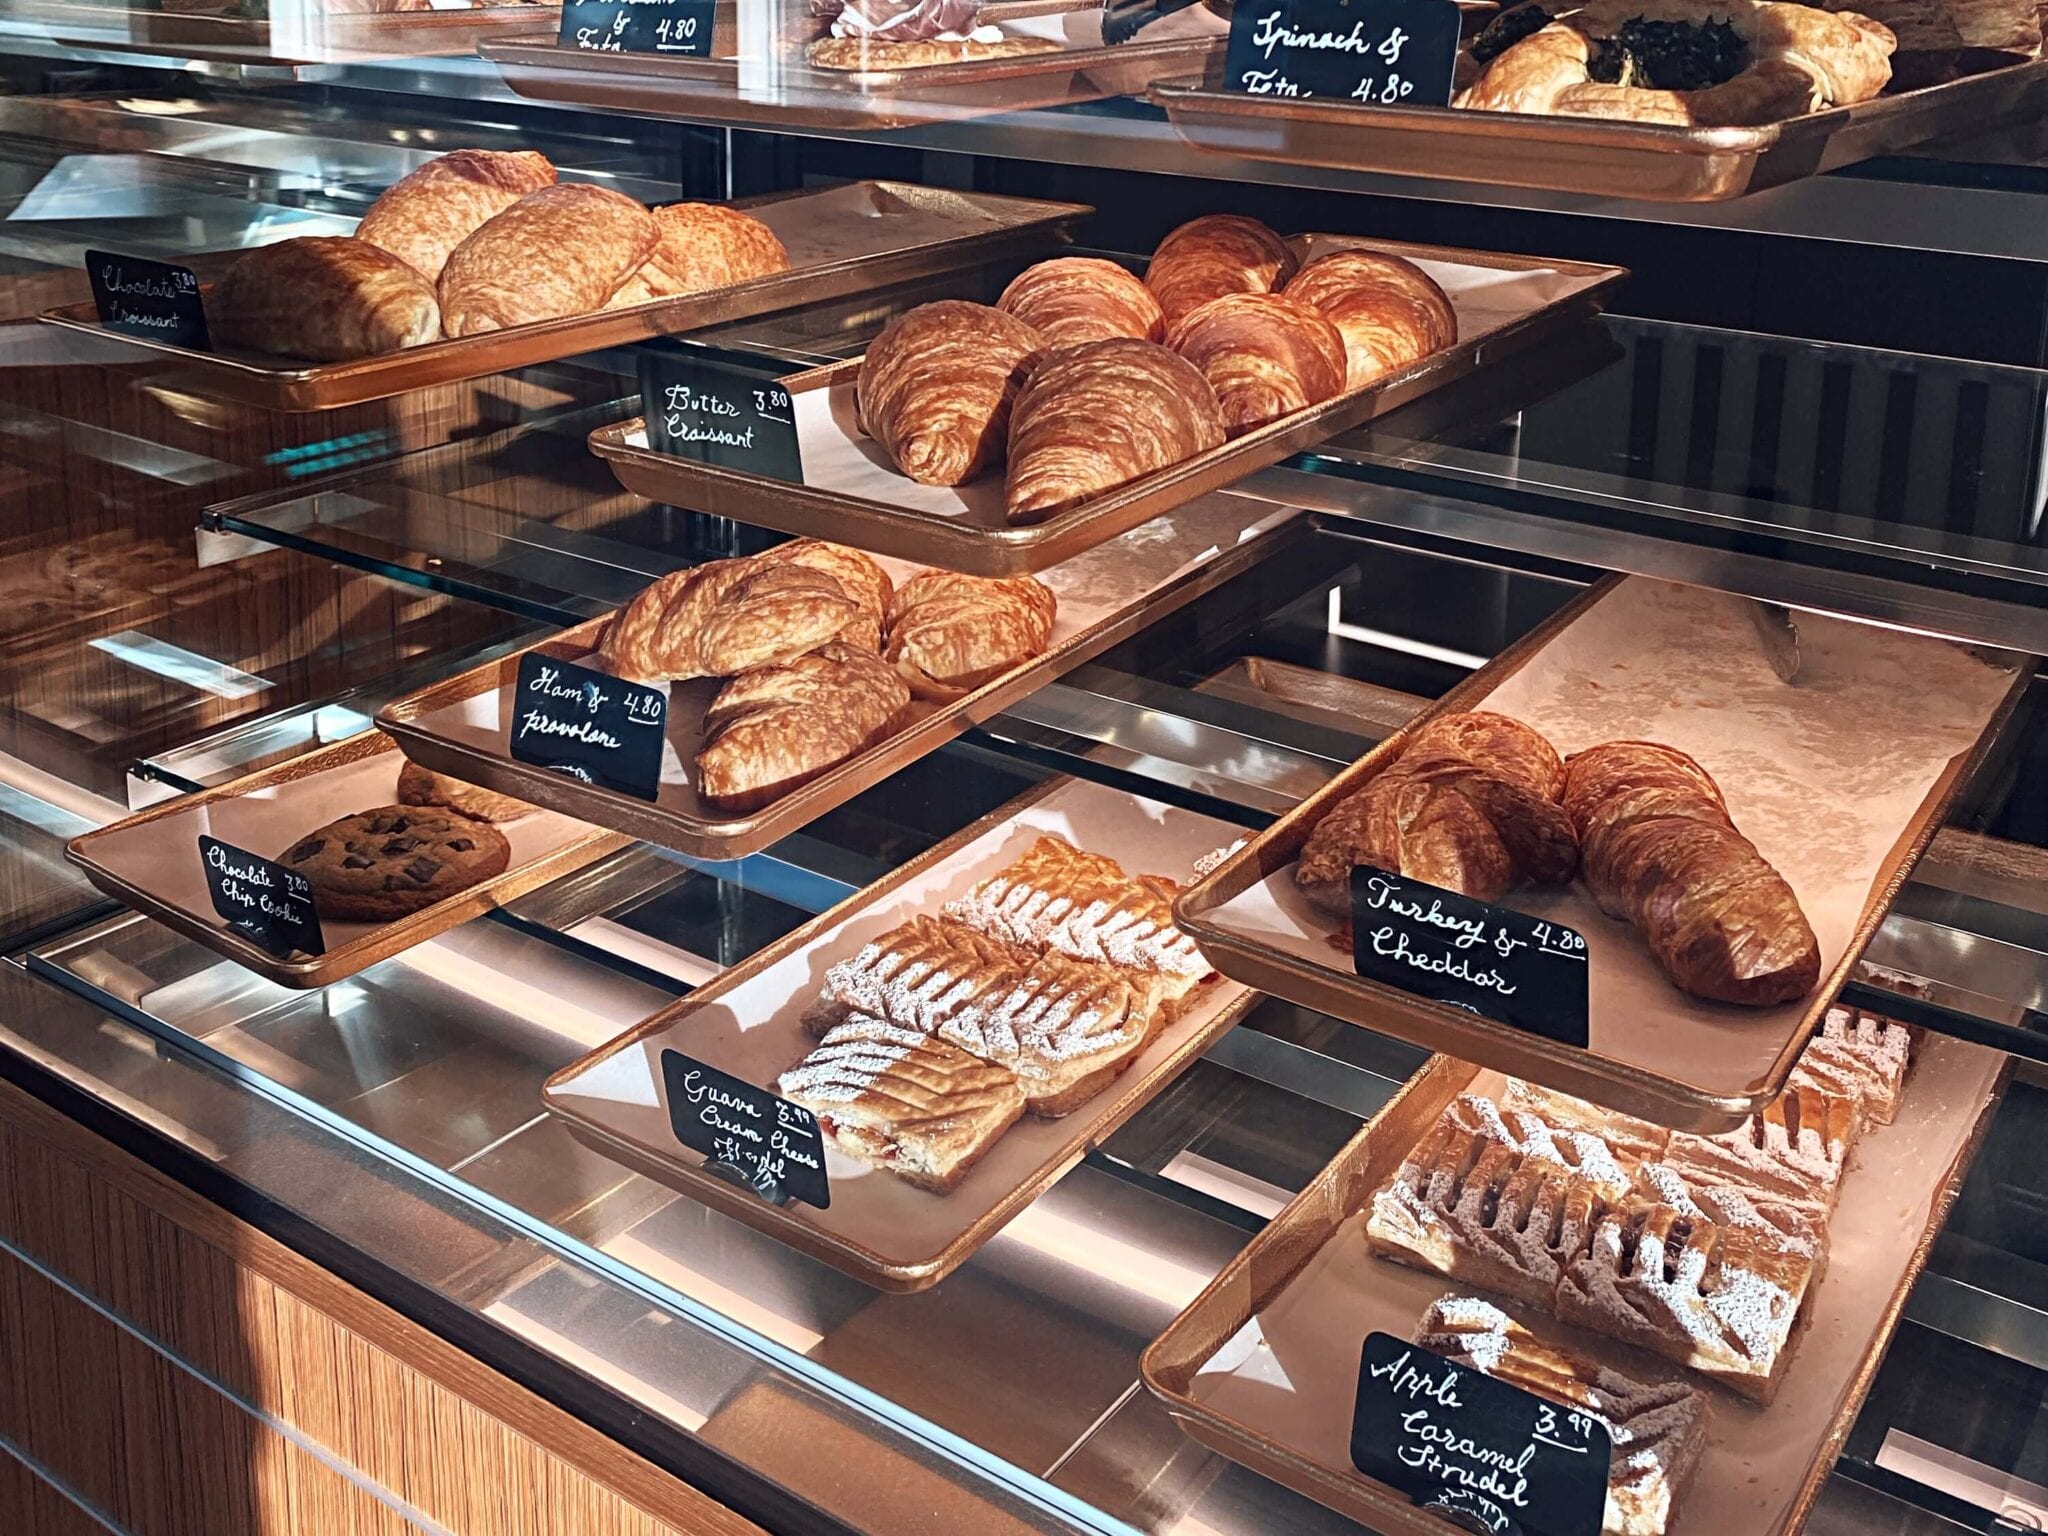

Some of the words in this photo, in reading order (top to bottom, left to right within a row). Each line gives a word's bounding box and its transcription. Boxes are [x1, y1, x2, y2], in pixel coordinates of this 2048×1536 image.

[656, 18, 696, 43] 4.80
[1253, 11, 1370, 59] Spinach
[1378, 27, 1409, 65] &
[1352, 74, 1414, 103] 4.80
[102, 265, 175, 298] Chocolate
[171, 272, 196, 289] 3.80
[110, 300, 180, 329] Croissant
[665, 384, 740, 417] Butter
[752, 390, 788, 411] 3.80
[664, 413, 754, 448] Croissant
[530, 667, 583, 702] Ham
[588, 687, 609, 713] &
[624, 693, 661, 717] 4.80
[207, 846, 275, 887] Chocolate
[284, 873, 309, 891] 3.80
[221, 878, 255, 908] Chip
[260, 894, 302, 924] Cookie
[1367, 877, 1487, 949] Turkey
[1495, 928, 1527, 957] &
[1531, 922, 1585, 949] 4.80
[1370, 926, 1517, 995] Cheddar
[684, 1070, 762, 1118] Guava
[775, 1101, 810, 1124] 3.99
[700, 1105, 763, 1142] Cream
[771, 1130, 819, 1169] Cheese
[1370, 1351, 1463, 1407] Apple
[1535, 1403, 1592, 1439] 3.99
[1401, 1409, 1536, 1478] Caramel
[1398, 1444, 1529, 1507] Strudel
